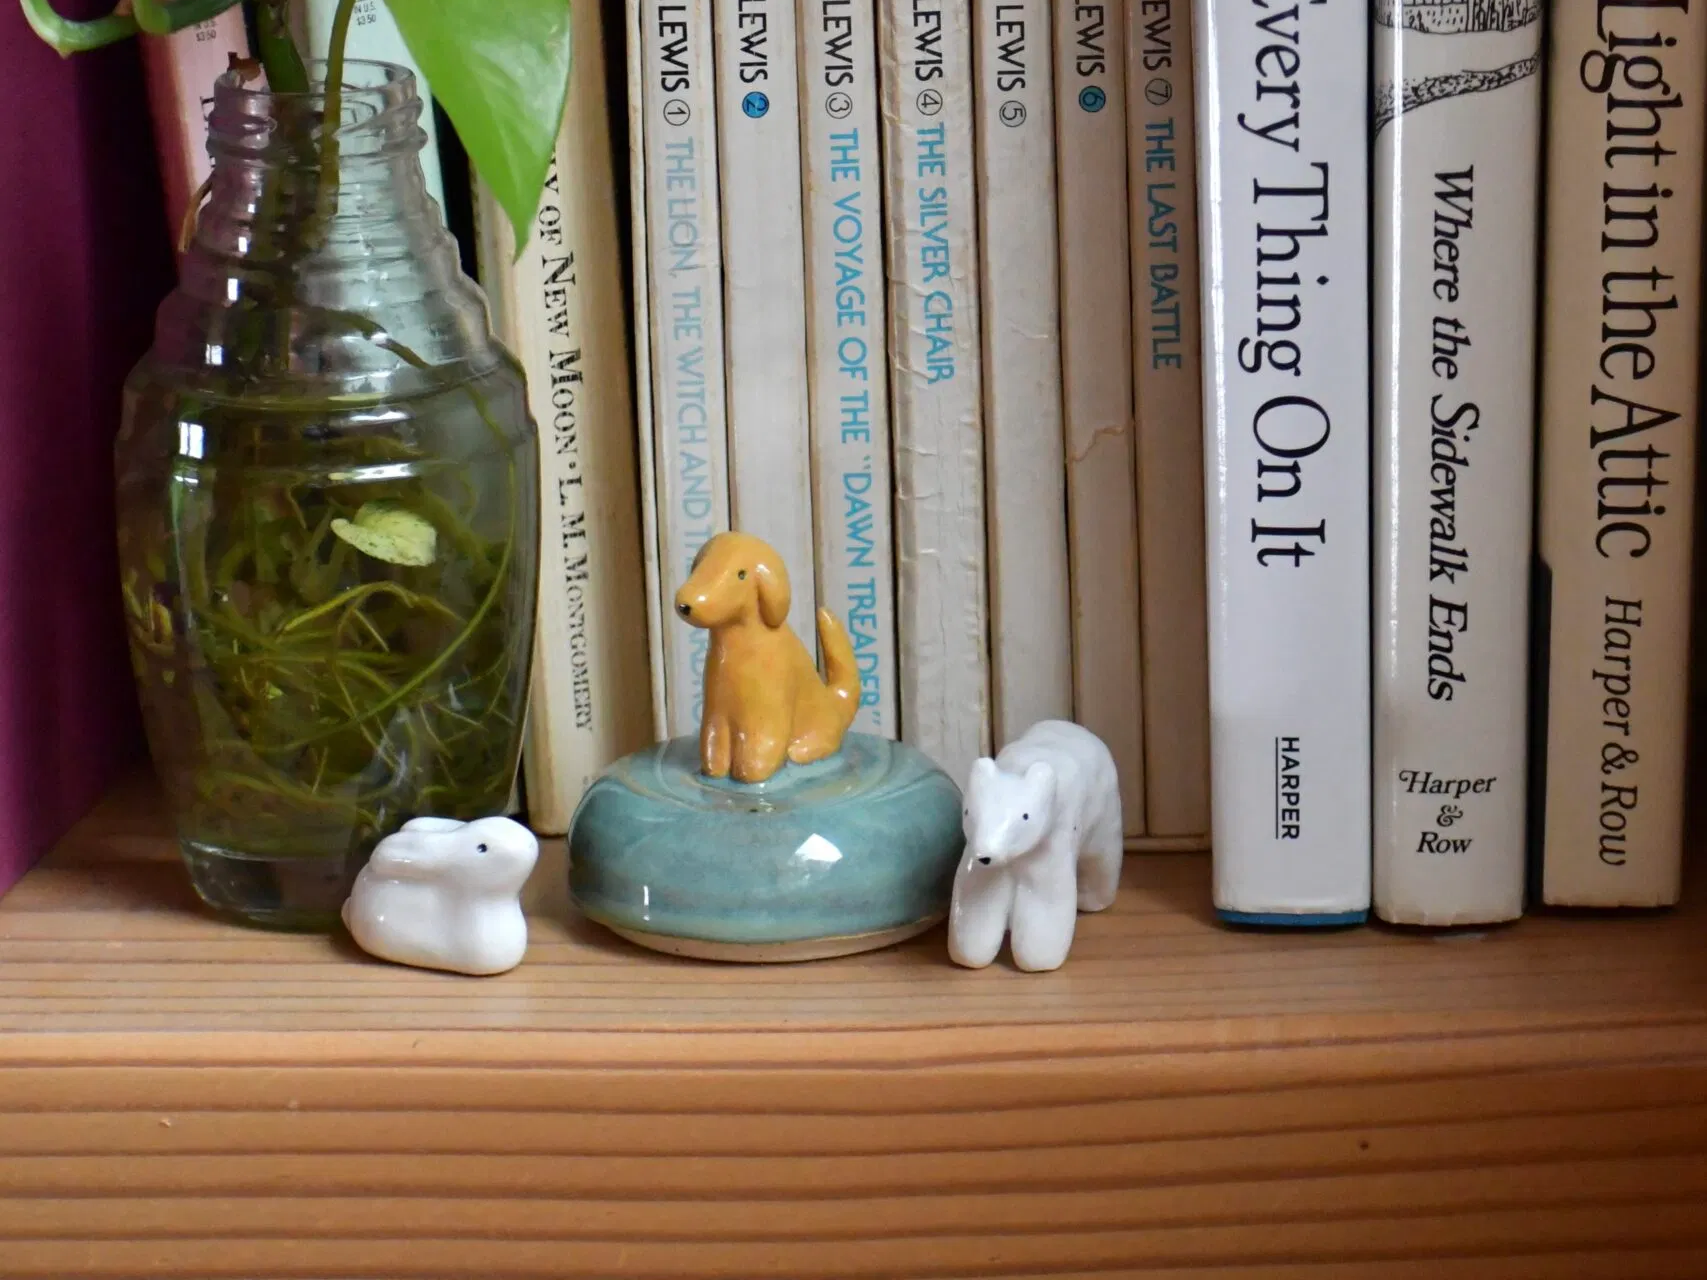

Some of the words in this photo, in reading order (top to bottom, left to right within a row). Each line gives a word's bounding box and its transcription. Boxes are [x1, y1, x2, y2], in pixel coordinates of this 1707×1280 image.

[665, 136, 695, 190] THE
[830, 127, 859, 182] THE
[917, 122, 944, 177] THE
[1146, 118, 1175, 172] THE
[538, 205, 562, 245] OF
[919, 186, 949, 284] SILVER
[1148, 182, 1177, 253] LAST
[1433, 165, 1473, 302] Where
[1601, 182, 1673, 252] in
[833, 191, 868, 326] VOYAGE
[1238, 162, 1329, 376] Thing
[542, 251, 576, 338] NEW
[672, 285, 703, 339] THE
[1150, 263, 1182, 370] BATTLE
[1600, 266, 1678, 380] the
[838, 336, 869, 382] OF
[923, 290, 954, 385] CHAIR
[1432, 316, 1471, 379] the
[548, 347, 584, 456] MOON
[675, 345, 708, 444] WITCH
[840, 390, 871, 443] THE
[1253, 396, 1330, 502] On
[1590, 385, 1682, 559] Attic
[557, 476, 584, 507] L.
[681, 452, 711, 520] AND
[1430, 394, 1480, 584] Sidewalk
[561, 512, 588, 549] M.
[1251, 518, 1325, 567] It
[564, 554, 594, 732] MONTGOMERY
[1428, 594, 1467, 701] Ends
[1592, 596, 1642, 736] Harper
[1281, 737, 1300, 839] HARPER
[1399, 770, 1496, 799] Harper
[1601, 742, 1639, 775] &
[1417, 832, 1472, 853] Row
[1436, 805, 1463, 827] &
[1599, 782, 1638, 866] Row
